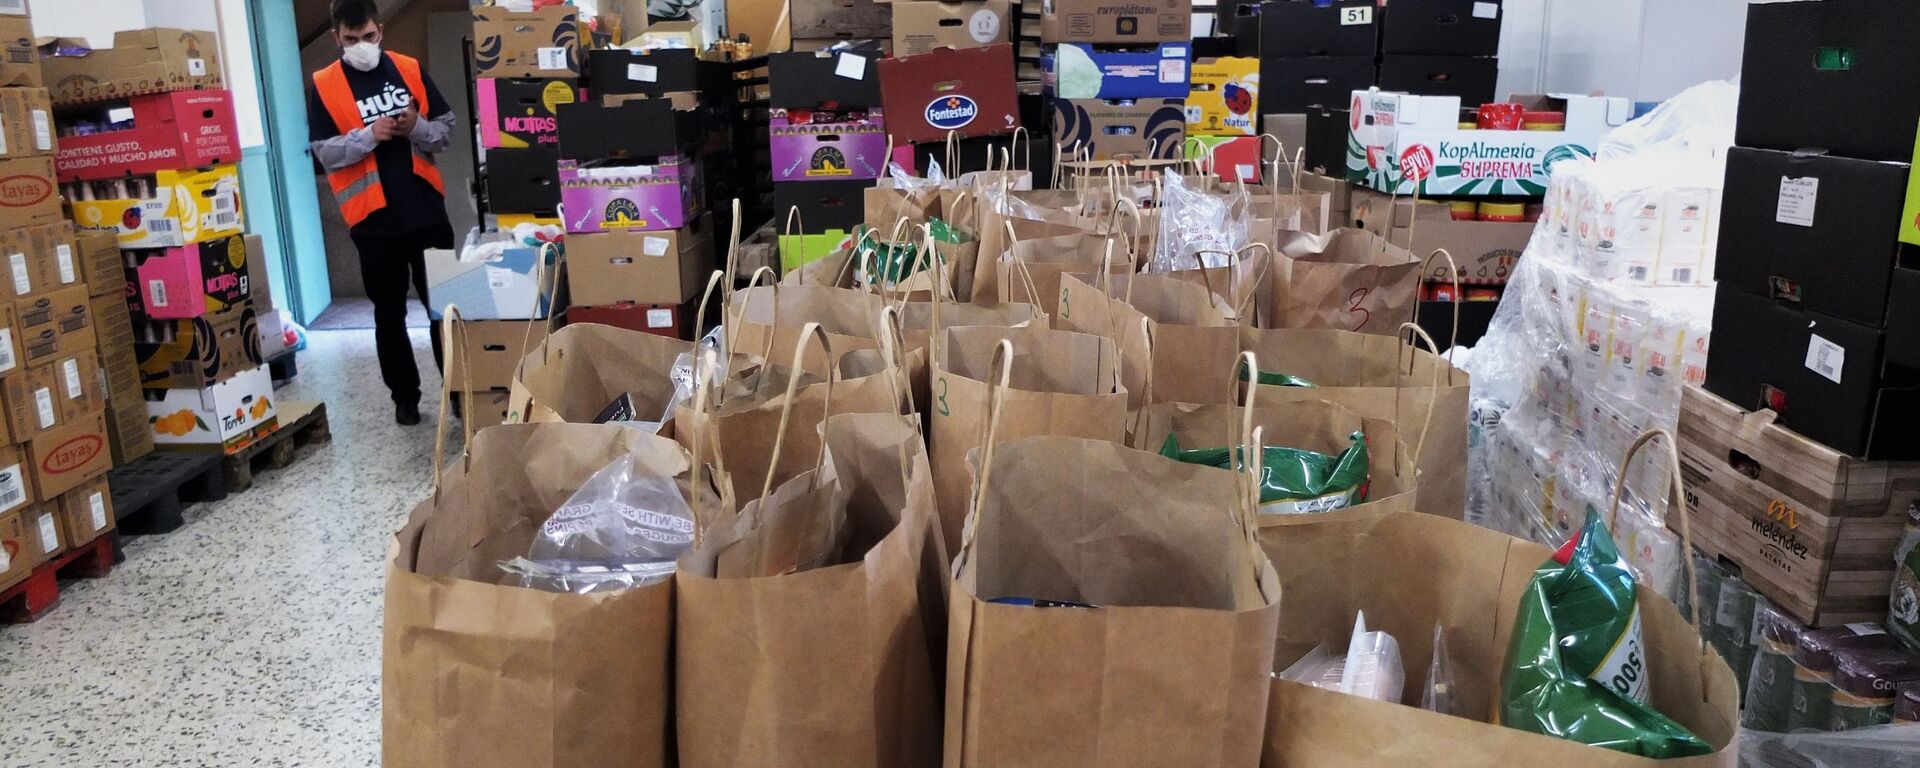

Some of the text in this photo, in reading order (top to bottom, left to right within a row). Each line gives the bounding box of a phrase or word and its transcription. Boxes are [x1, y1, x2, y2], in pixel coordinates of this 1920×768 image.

[1347, 8, 1366, 22] 51
[356, 88, 410, 119] HUG
[929, 104, 974, 121] Fontestad
[1223, 118, 1250, 128] Natur
[58, 148, 177, 170] CALIDAD Y MUCHO AMOR
[1439, 141, 1535, 162] KopAlmería
[1460, 161, 1533, 179] SUPREMA
[1062, 288, 1070, 319] 3
[1350, 288, 1369, 332] 3
[938, 377, 949, 417] 3
[1751, 517, 1808, 560] meléndez
